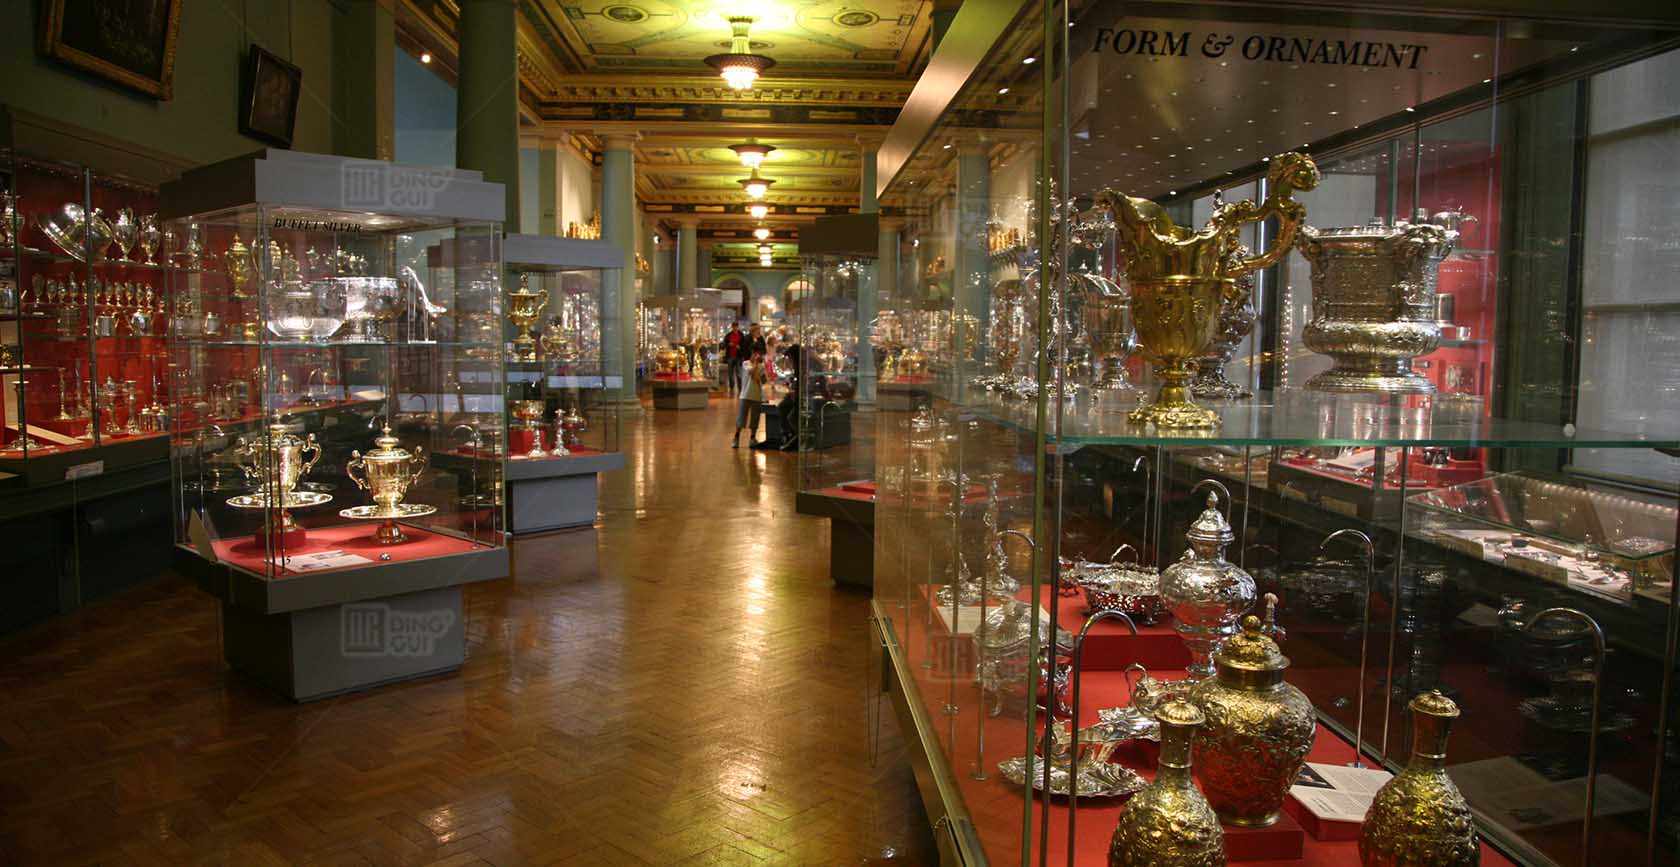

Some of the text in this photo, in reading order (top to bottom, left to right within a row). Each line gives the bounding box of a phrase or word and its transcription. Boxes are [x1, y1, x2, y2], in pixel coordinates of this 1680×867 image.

[1092, 27, 1428, 70] FORM & ORNAMENT
[274, 217, 362, 233] BUFFET SILVER
